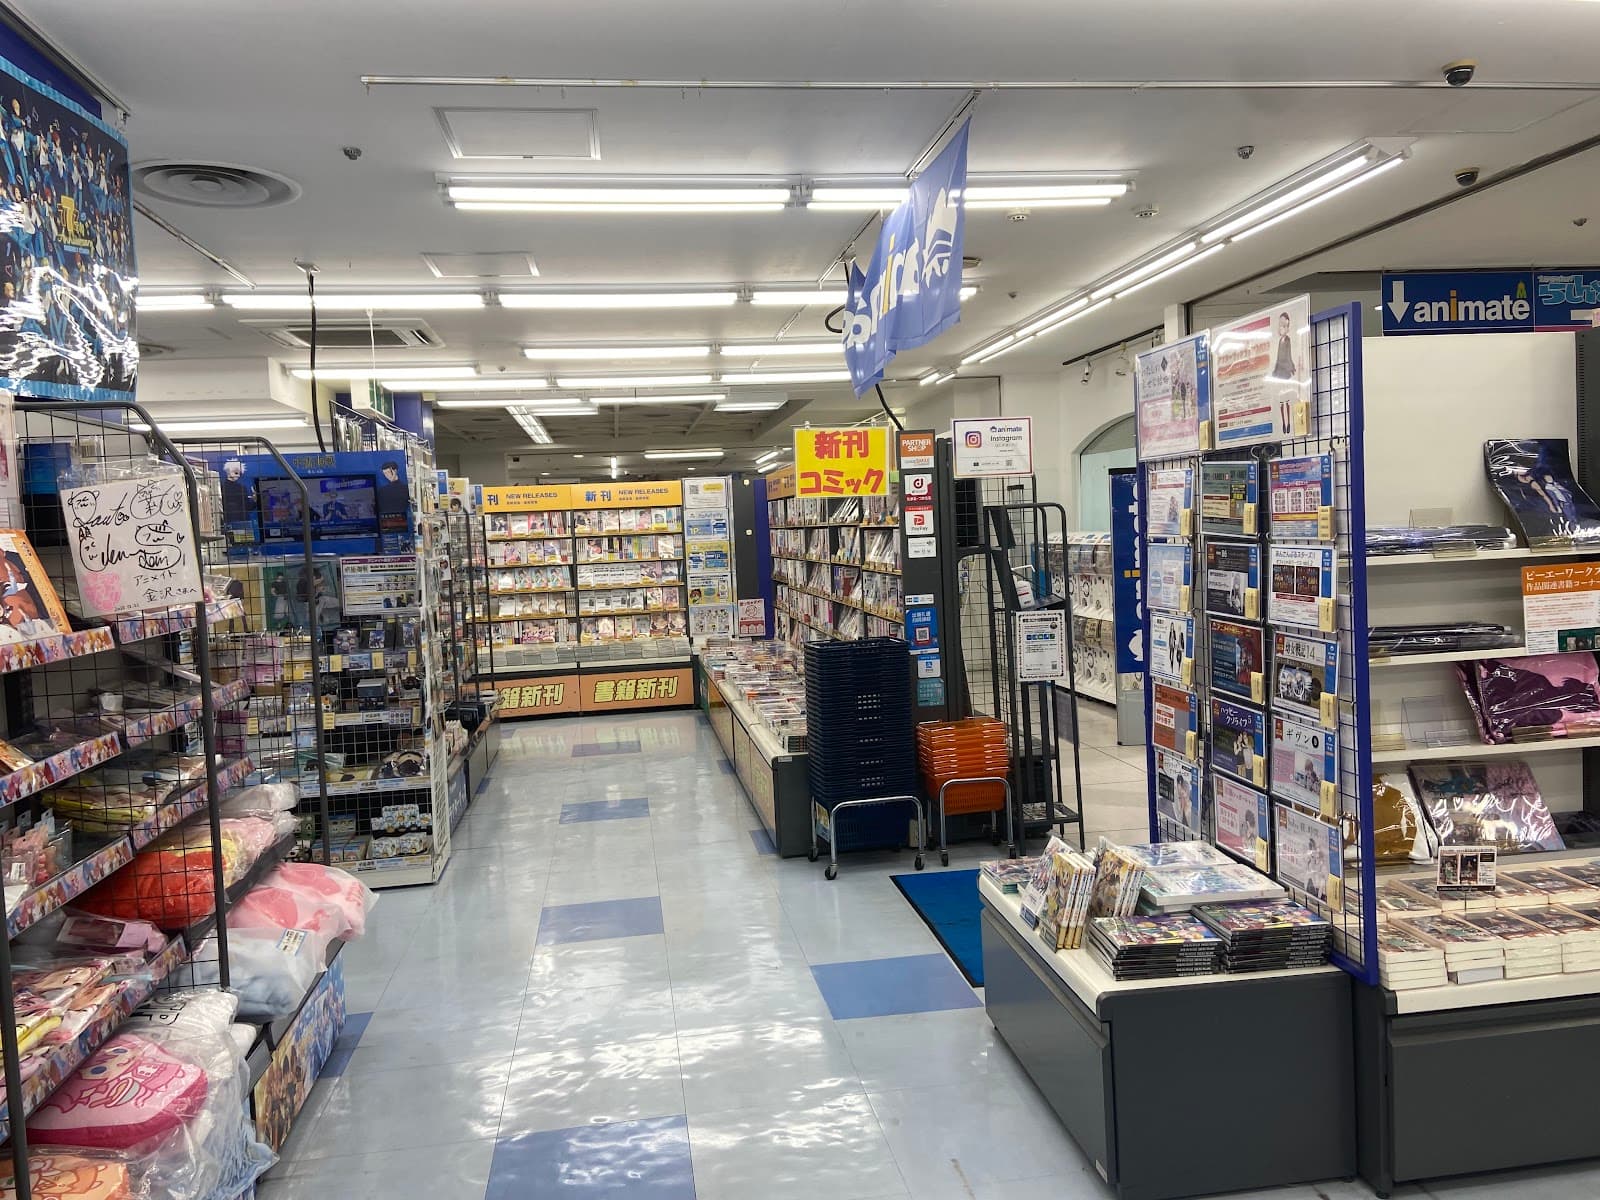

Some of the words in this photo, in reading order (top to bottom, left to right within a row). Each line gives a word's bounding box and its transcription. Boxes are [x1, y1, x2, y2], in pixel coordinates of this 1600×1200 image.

[1413, 289, 1530, 323] animate
[815, 430, 869, 459] 新刊
[901, 438, 931, 447] PARTNER
[990, 435, 1023, 443] Instagram
[800, 468, 884, 495] コミック
[522, 491, 558, 499] RELEASES
[585, 490, 612, 502] 新刊
[635, 487, 669, 495] RELEASES
[133, 570, 177, 586] アニメイト
[494, 683, 565, 711] 籍新刊
[594, 676, 679, 703] 書籍新刊
